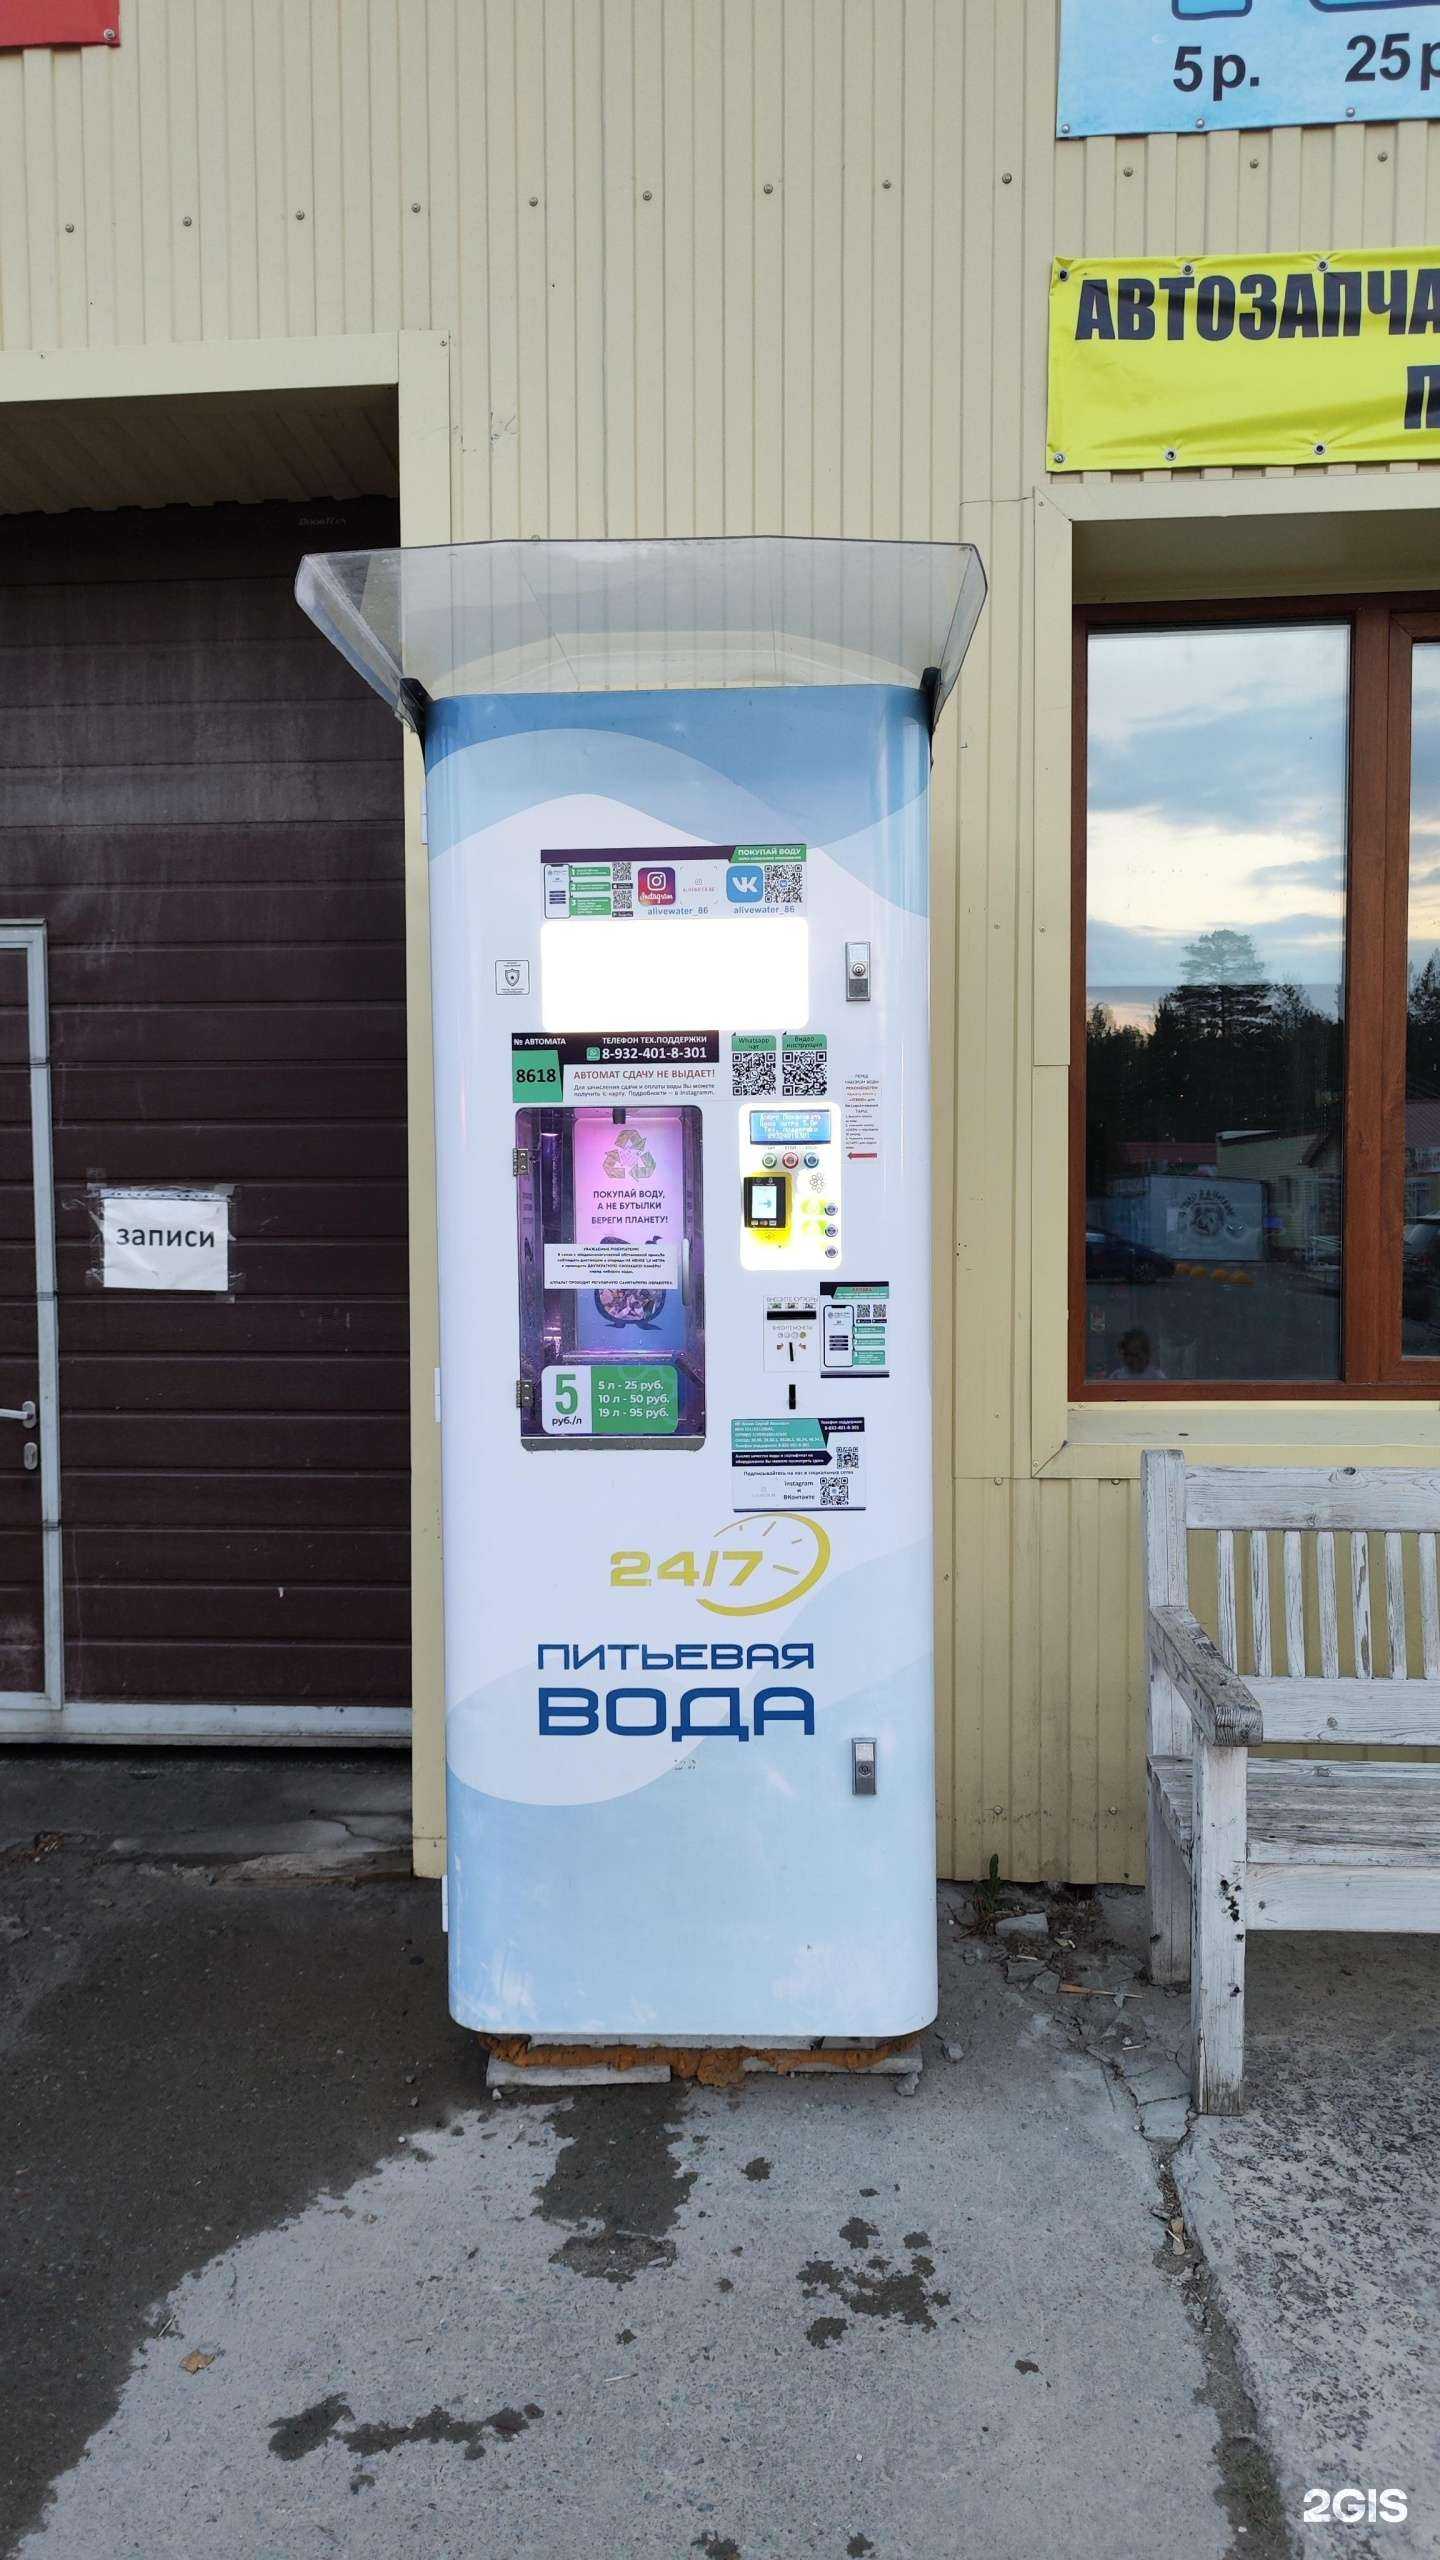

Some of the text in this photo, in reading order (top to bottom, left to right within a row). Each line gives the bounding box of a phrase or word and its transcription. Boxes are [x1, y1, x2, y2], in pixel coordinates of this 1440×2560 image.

[1074, 268, 1440, 341] АВТОЗАПЧА
[738, 847, 801, 856] ПОКУПАЙ ВОДУ
[647, 907, 709, 916] alivewater_86
[733, 905, 795, 915] alivewater_86
[513, 1038, 524, 1046] №
[602, 1036, 707, 1045] ТЕЛЕФОН ТЕХ.ПОДДЕРЖКИ
[602, 1047, 707, 1059] 8-932-401-8-301
[516, 1068, 556, 1083] 8618
[574, 1070, 715, 1080] АВТОМАТ СДАЧУ НЕ ВЫДАЕТ!
[593, 1189, 666, 1199] ПОКУПАЙ ВОДУ,
[619, 1202, 662, 1210] БУТЫЛКИ
[591, 1216, 668, 1224] БЕРЕГИ ПЛАНЕТУ!
[116, 1228, 215, 1248] записи
[598, 1381, 605, 1390] 5
[624, 1381, 638, 1390] 25
[640, 1380, 664, 1391] руб.
[555, 1374, 578, 1415] 5
[598, 1395, 610, 1403] 10
[630, 1394, 644, 1403] 50
[646, 1394, 670, 1405] руб.
[598, 1408, 610, 1417] 19
[629, 1408, 643, 1417] 95
[645, 1407, 669, 1418] руб.
[552, 1416, 582, 1426] руб./л
[609, 1550, 763, 1587] 24/7
[537, 1643, 814, 1670] ПИТЬЕВАЯ
[538, 1686, 815, 1742] ВОДА
